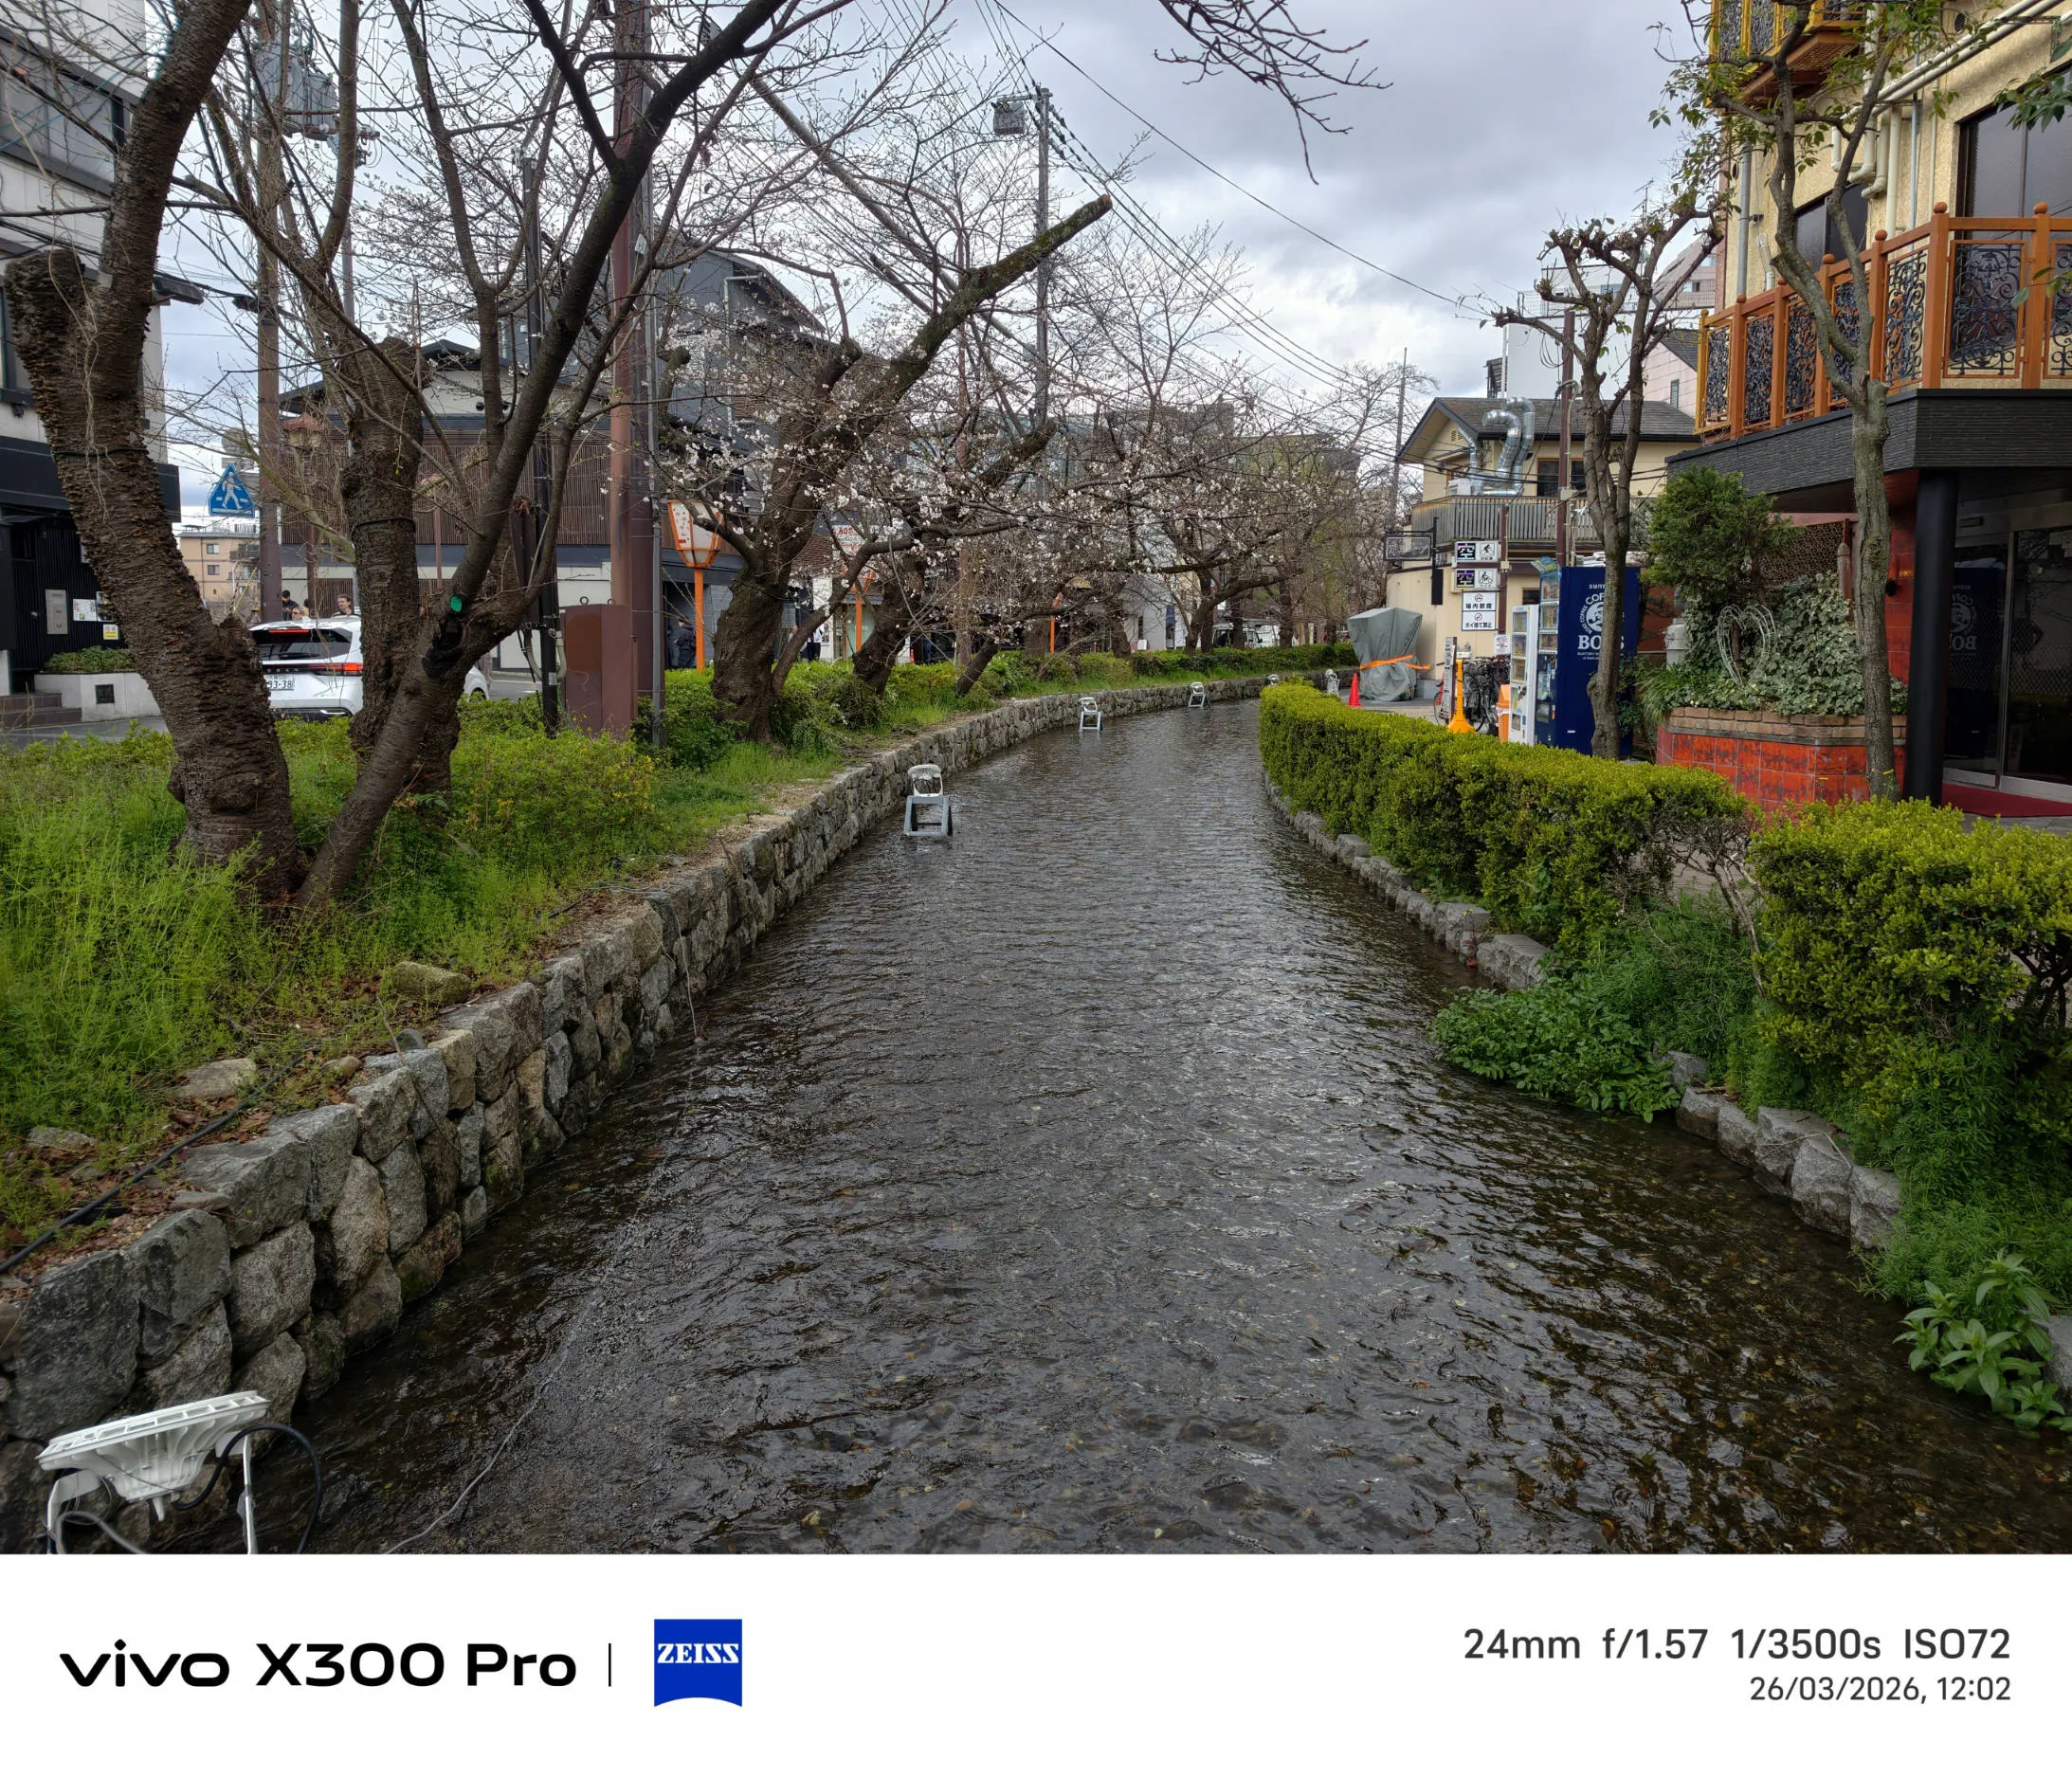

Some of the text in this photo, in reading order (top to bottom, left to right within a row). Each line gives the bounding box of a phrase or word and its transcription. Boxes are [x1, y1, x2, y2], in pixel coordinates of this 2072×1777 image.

[1457, 542, 1476, 560] 空
[1456, 571, 1475, 588] 空
[1586, 593, 1605, 605] COF
